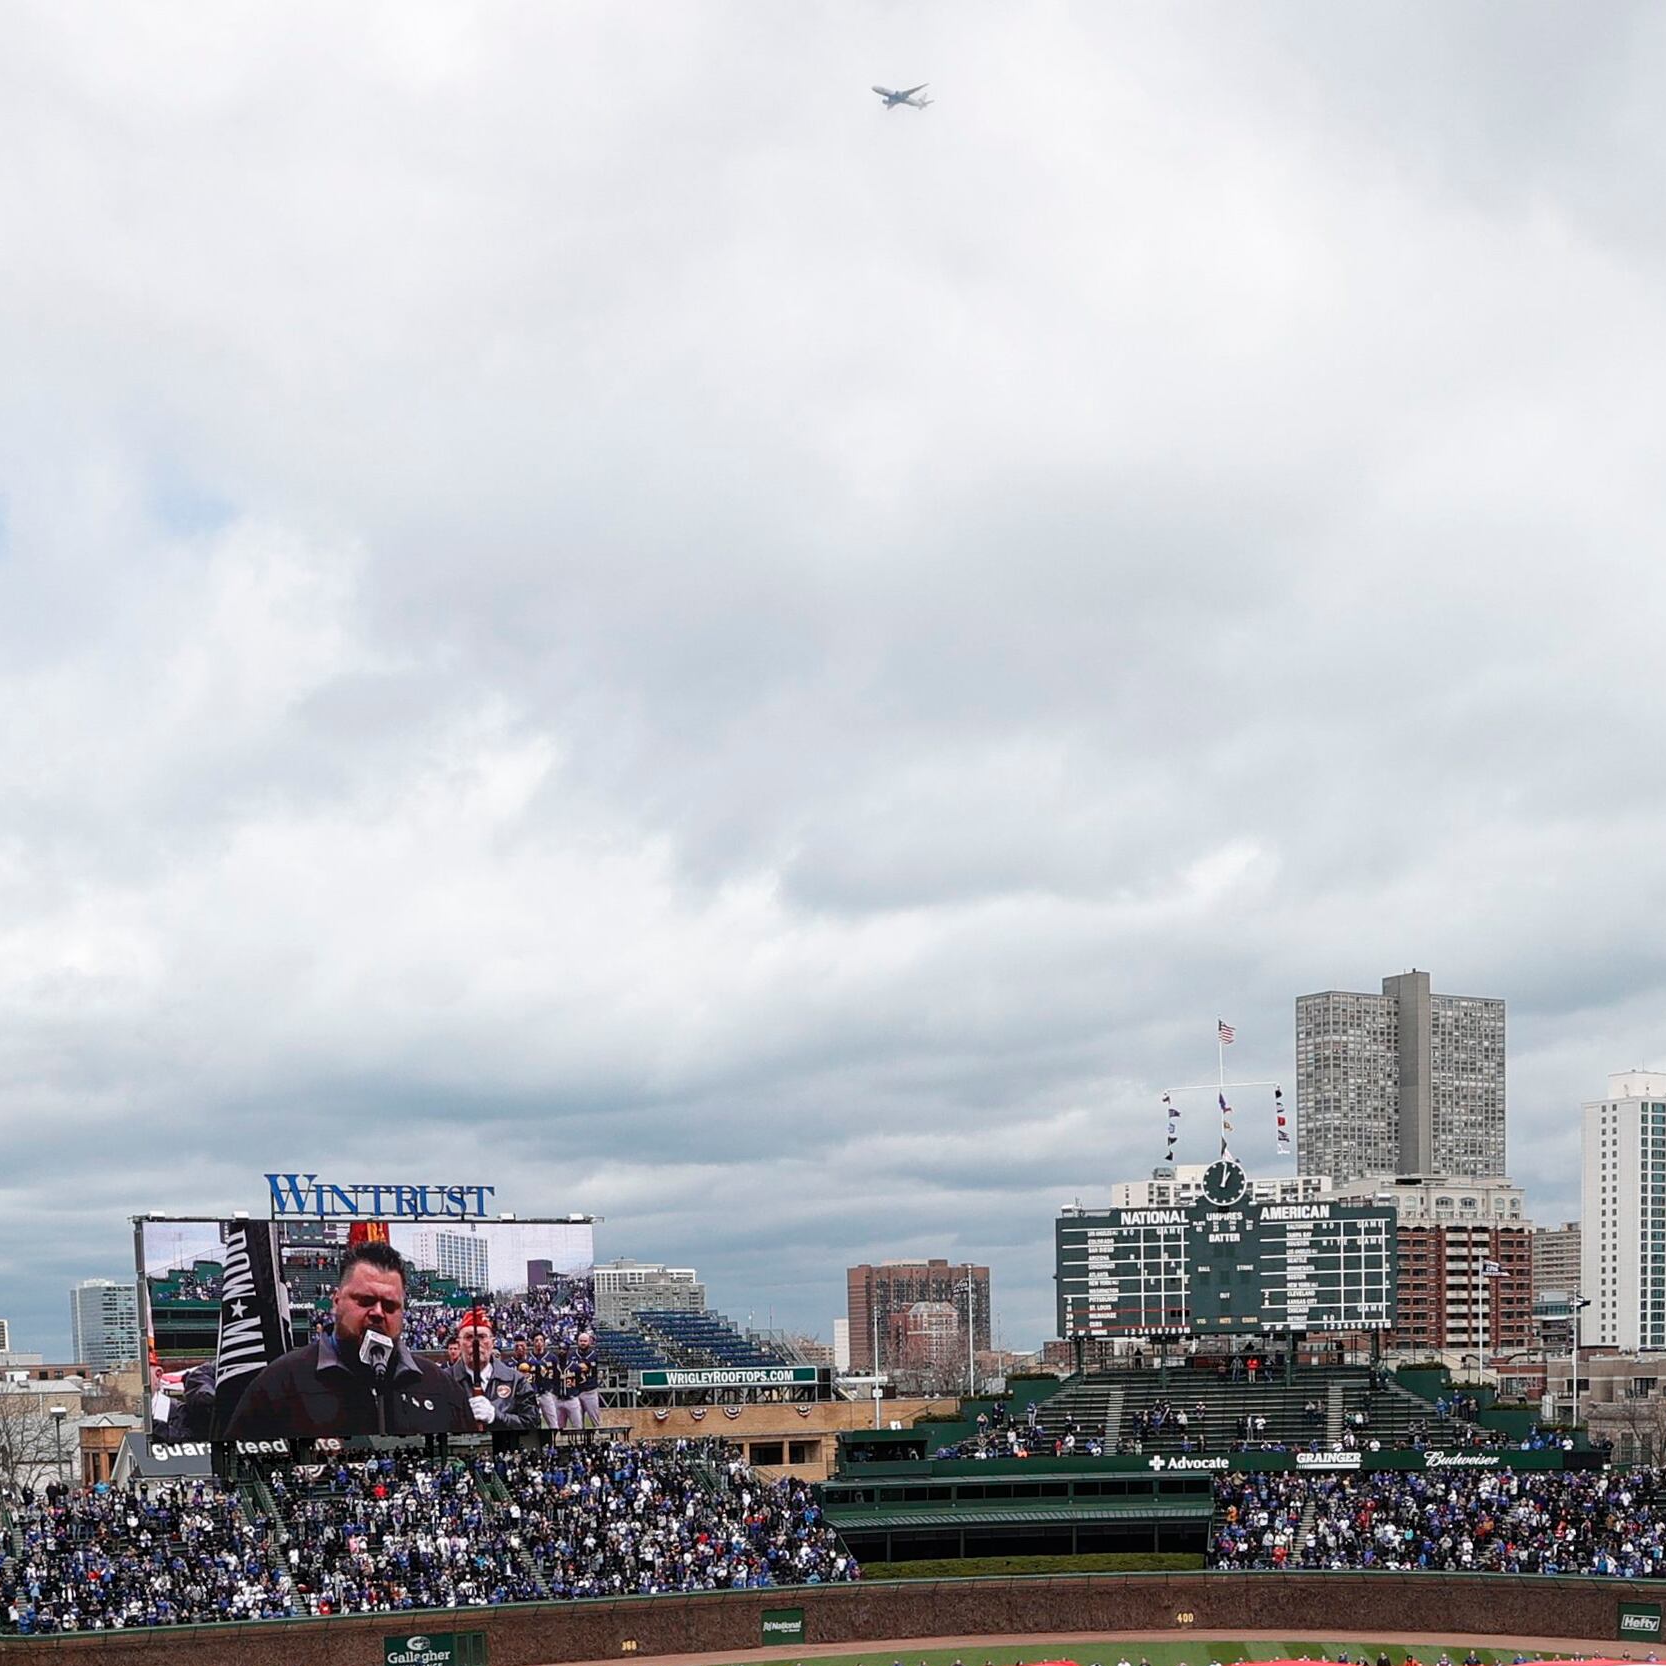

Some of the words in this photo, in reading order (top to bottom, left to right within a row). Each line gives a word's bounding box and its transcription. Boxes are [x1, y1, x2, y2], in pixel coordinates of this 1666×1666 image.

[264, 1174, 494, 1217] WINTRUST
[1121, 1210, 1189, 1225] NATIONAL
[1206, 1212, 1242, 1221] UMPIRES
[1260, 1205, 1329, 1220] AMERICAN
[1209, 1233, 1240, 1242] BATTER
[288, 1301, 315, 1310] dvocate
[215, 1316, 267, 1388] MIA
[666, 1370, 793, 1385] WRIGLEYROOFTOPS.COM
[151, 1438, 289, 1461] guarteed
[1168, 1456, 1229, 1469] Advocate
[1296, 1452, 1361, 1464] GRAINGER
[1424, 1451, 1499, 1467] Budweiser
[772, 1620, 801, 1630] National
[1177, 1613, 1193, 1623] 400
[1624, 1617, 1657, 1631] Hefty
[387, 1650, 451, 1664] Gallagher
